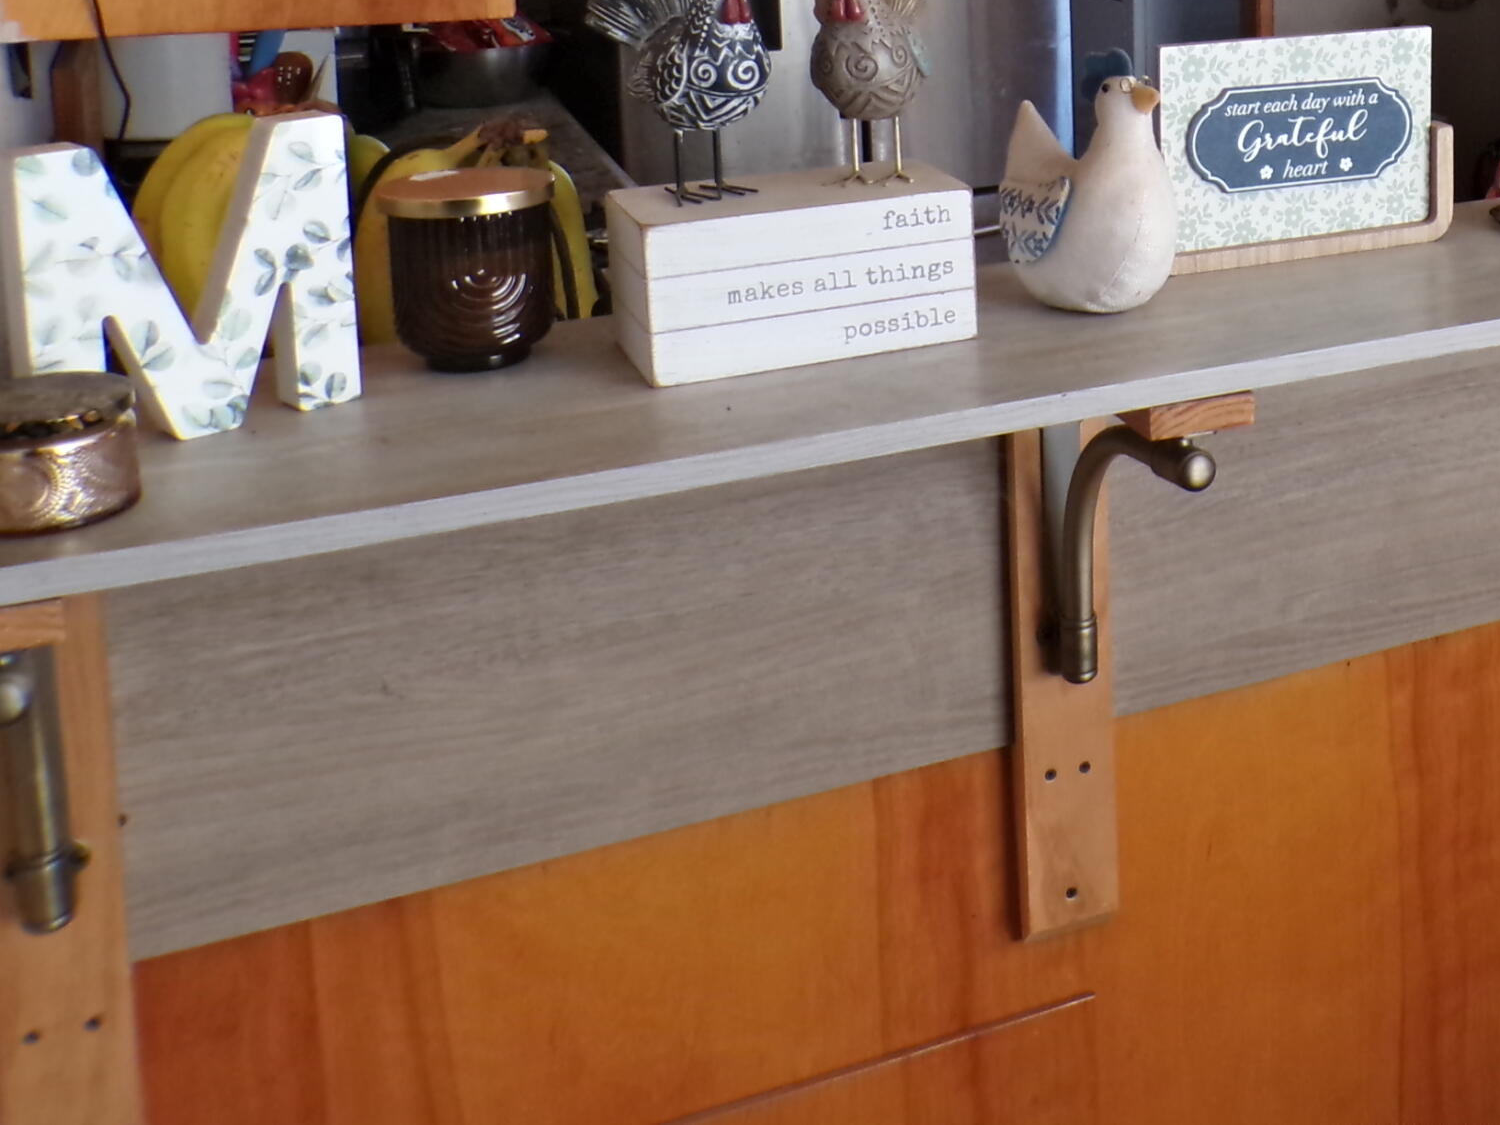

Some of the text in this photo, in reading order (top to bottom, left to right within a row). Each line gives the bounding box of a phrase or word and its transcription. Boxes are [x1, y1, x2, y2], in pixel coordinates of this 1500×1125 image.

[1223, 88, 1379, 118] start each day with a
[1237, 109, 1369, 163] Grateful
[1282, 158, 1328, 180] heart
[882, 204, 952, 231] faith
[727, 259, 954, 305] makes all things
[844, 307, 958, 344] possible
